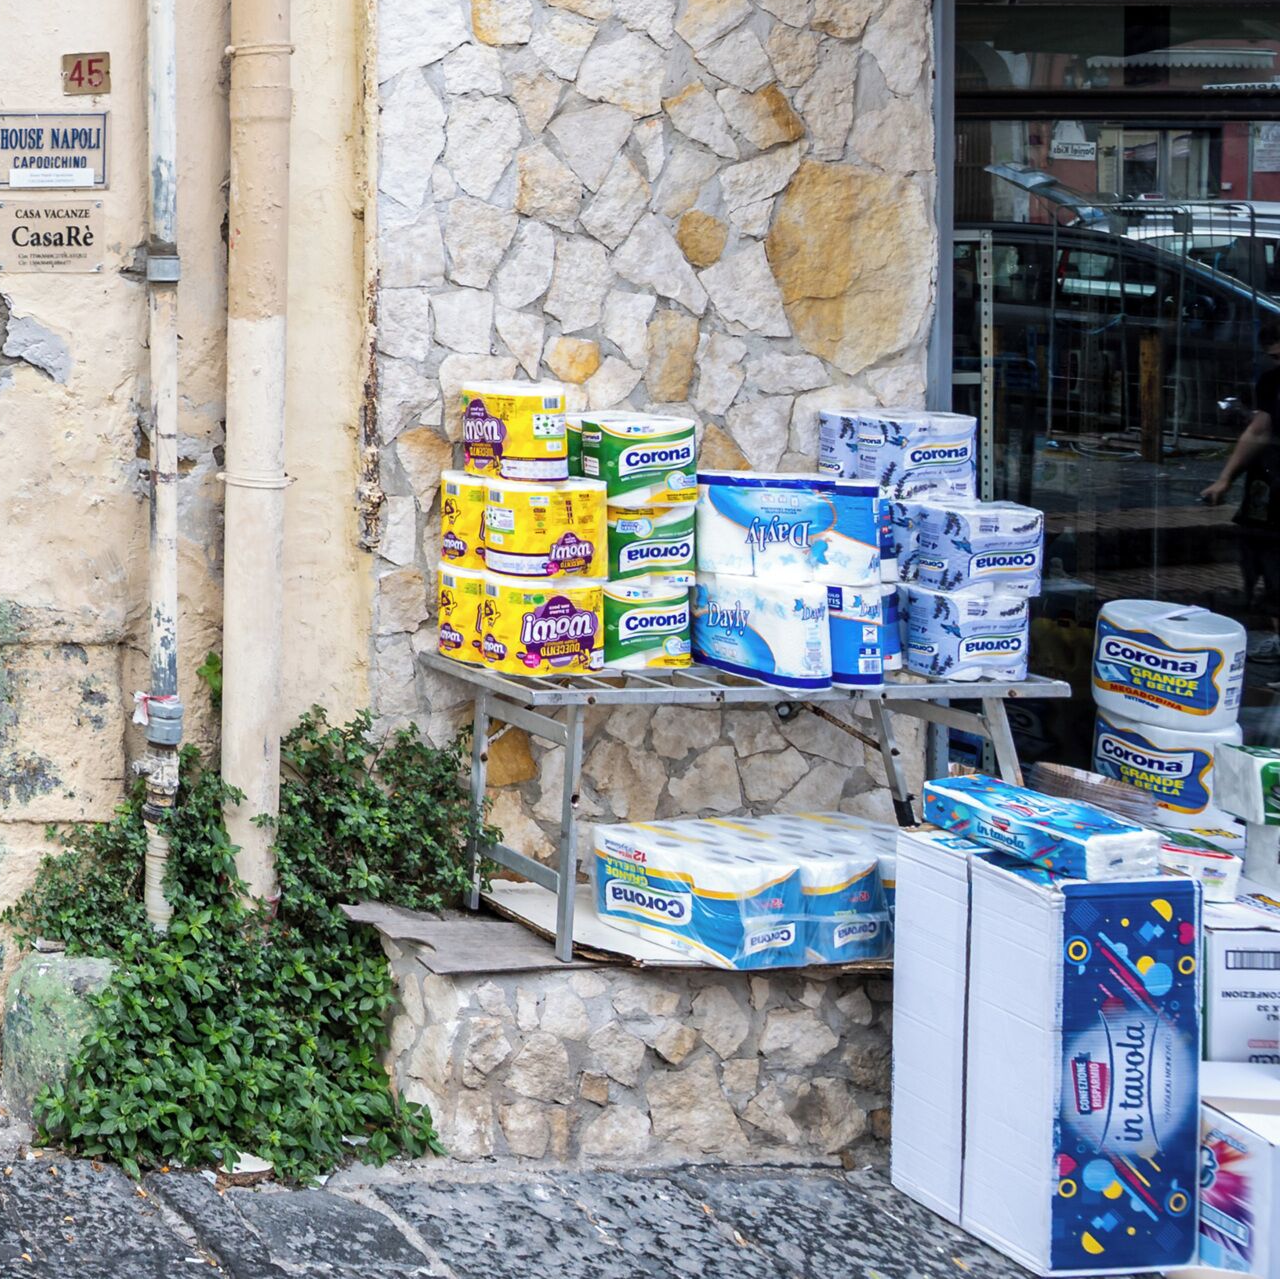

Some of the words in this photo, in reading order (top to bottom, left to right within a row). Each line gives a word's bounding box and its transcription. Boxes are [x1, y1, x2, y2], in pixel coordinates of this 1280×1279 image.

[69, 58, 104, 88] 45
[0, 128, 44, 150] HOUSE
[51, 127, 101, 150] NAPOLI
[15, 209, 41, 219] CASA
[44, 209, 90, 219] VACANZE
[11, 225, 94, 247] CasaRè
[625, 447, 690, 467] Corona
[910, 446, 968, 463] Corona
[627, 543, 690, 561] Corona
[976, 553, 1036, 568] Corona
[625, 612, 687, 631] Corona
[707, 600, 750, 636] Dayly
[965, 637, 1022, 652] Corona
[1105, 641, 1198, 674] Corona
[1130, 667, 1199, 691] GRANDE
[1132, 677, 1142, 686] &
[1146, 681, 1194, 698] BELLA
[1109, 683, 1183, 711] MEGABOBINA
[1102, 739, 1183, 773] Corona
[1119, 763, 1185, 789] GRANDE
[1134, 779, 1180, 796] BELLA
[989, 827, 1026, 850] tavola
[633, 850, 647, 863] 12
[611, 886, 685, 918] Corona
[750, 929, 791, 946] Corona
[1115, 1021, 1146, 1111] tavola
[1076, 1061, 1089, 1111] CONFEZIONE
[1088, 1063, 1102, 1108] RISPARMIO
[1116, 1113, 1144, 1142] in
